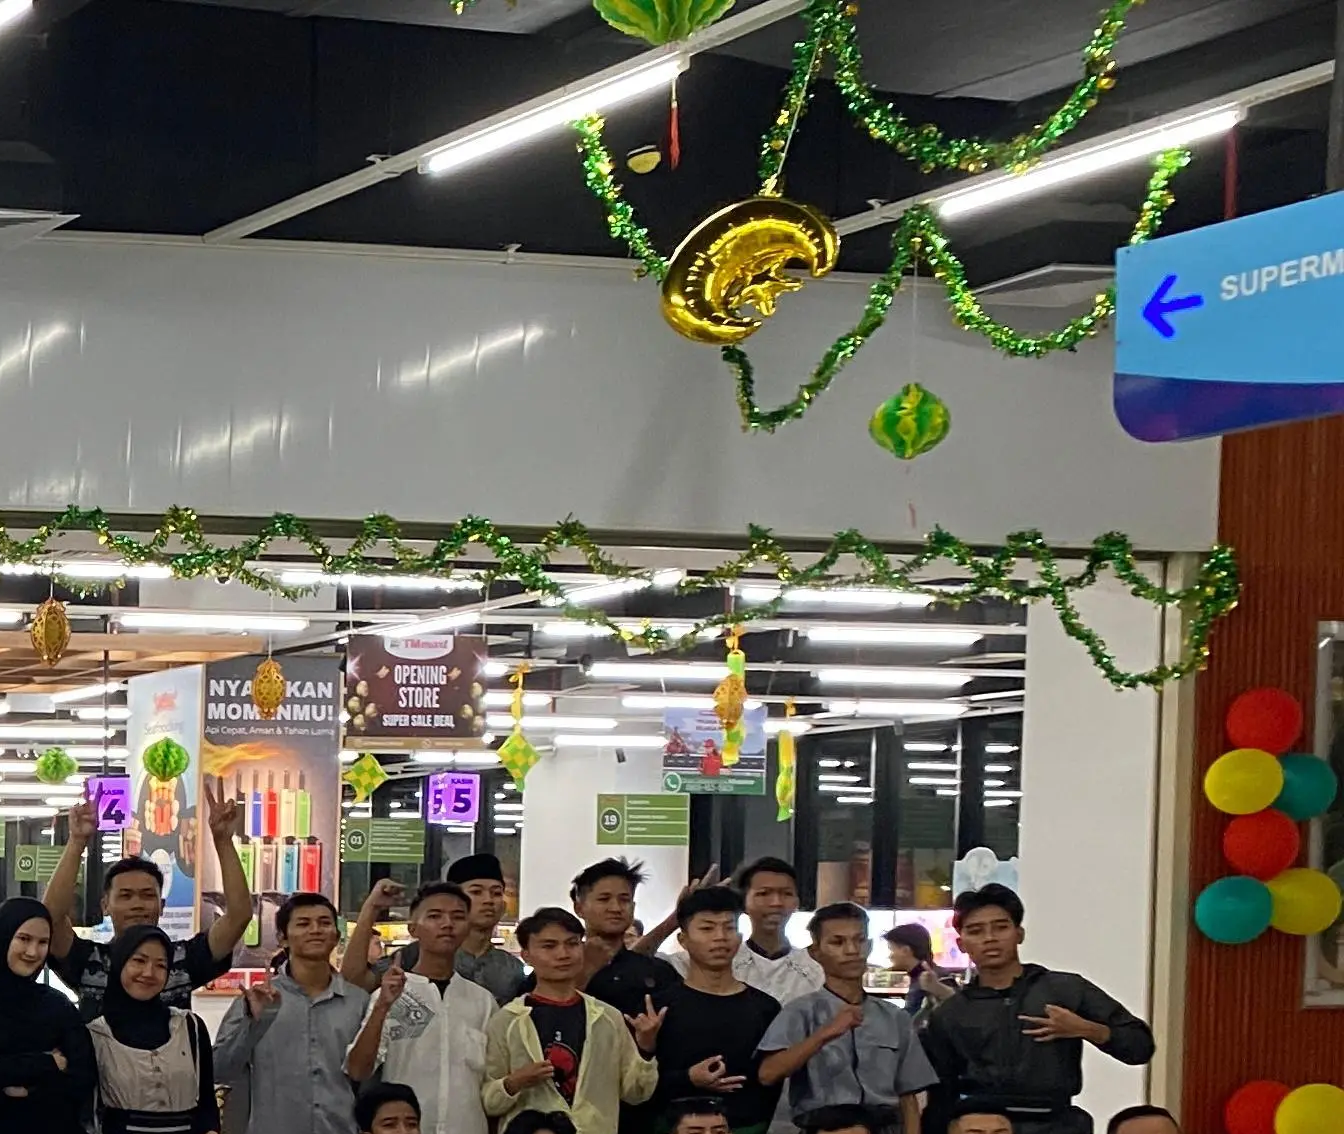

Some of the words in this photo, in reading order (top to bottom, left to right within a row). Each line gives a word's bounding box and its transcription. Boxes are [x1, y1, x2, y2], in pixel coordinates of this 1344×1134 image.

[1220, 249, 1344, 301] SUPERM
[394, 665, 447, 684] OPENING
[209, 679, 333, 698] NYAKAN
[398, 687, 440, 708] STORE
[207, 702, 333, 721] MOMNMU!
[382, 714, 409, 727] SUPER
[411, 714, 432, 727] SALE
[434, 714, 455, 728] DEAL
[453, 788, 472, 813] 5
[103, 799, 125, 824] 4
